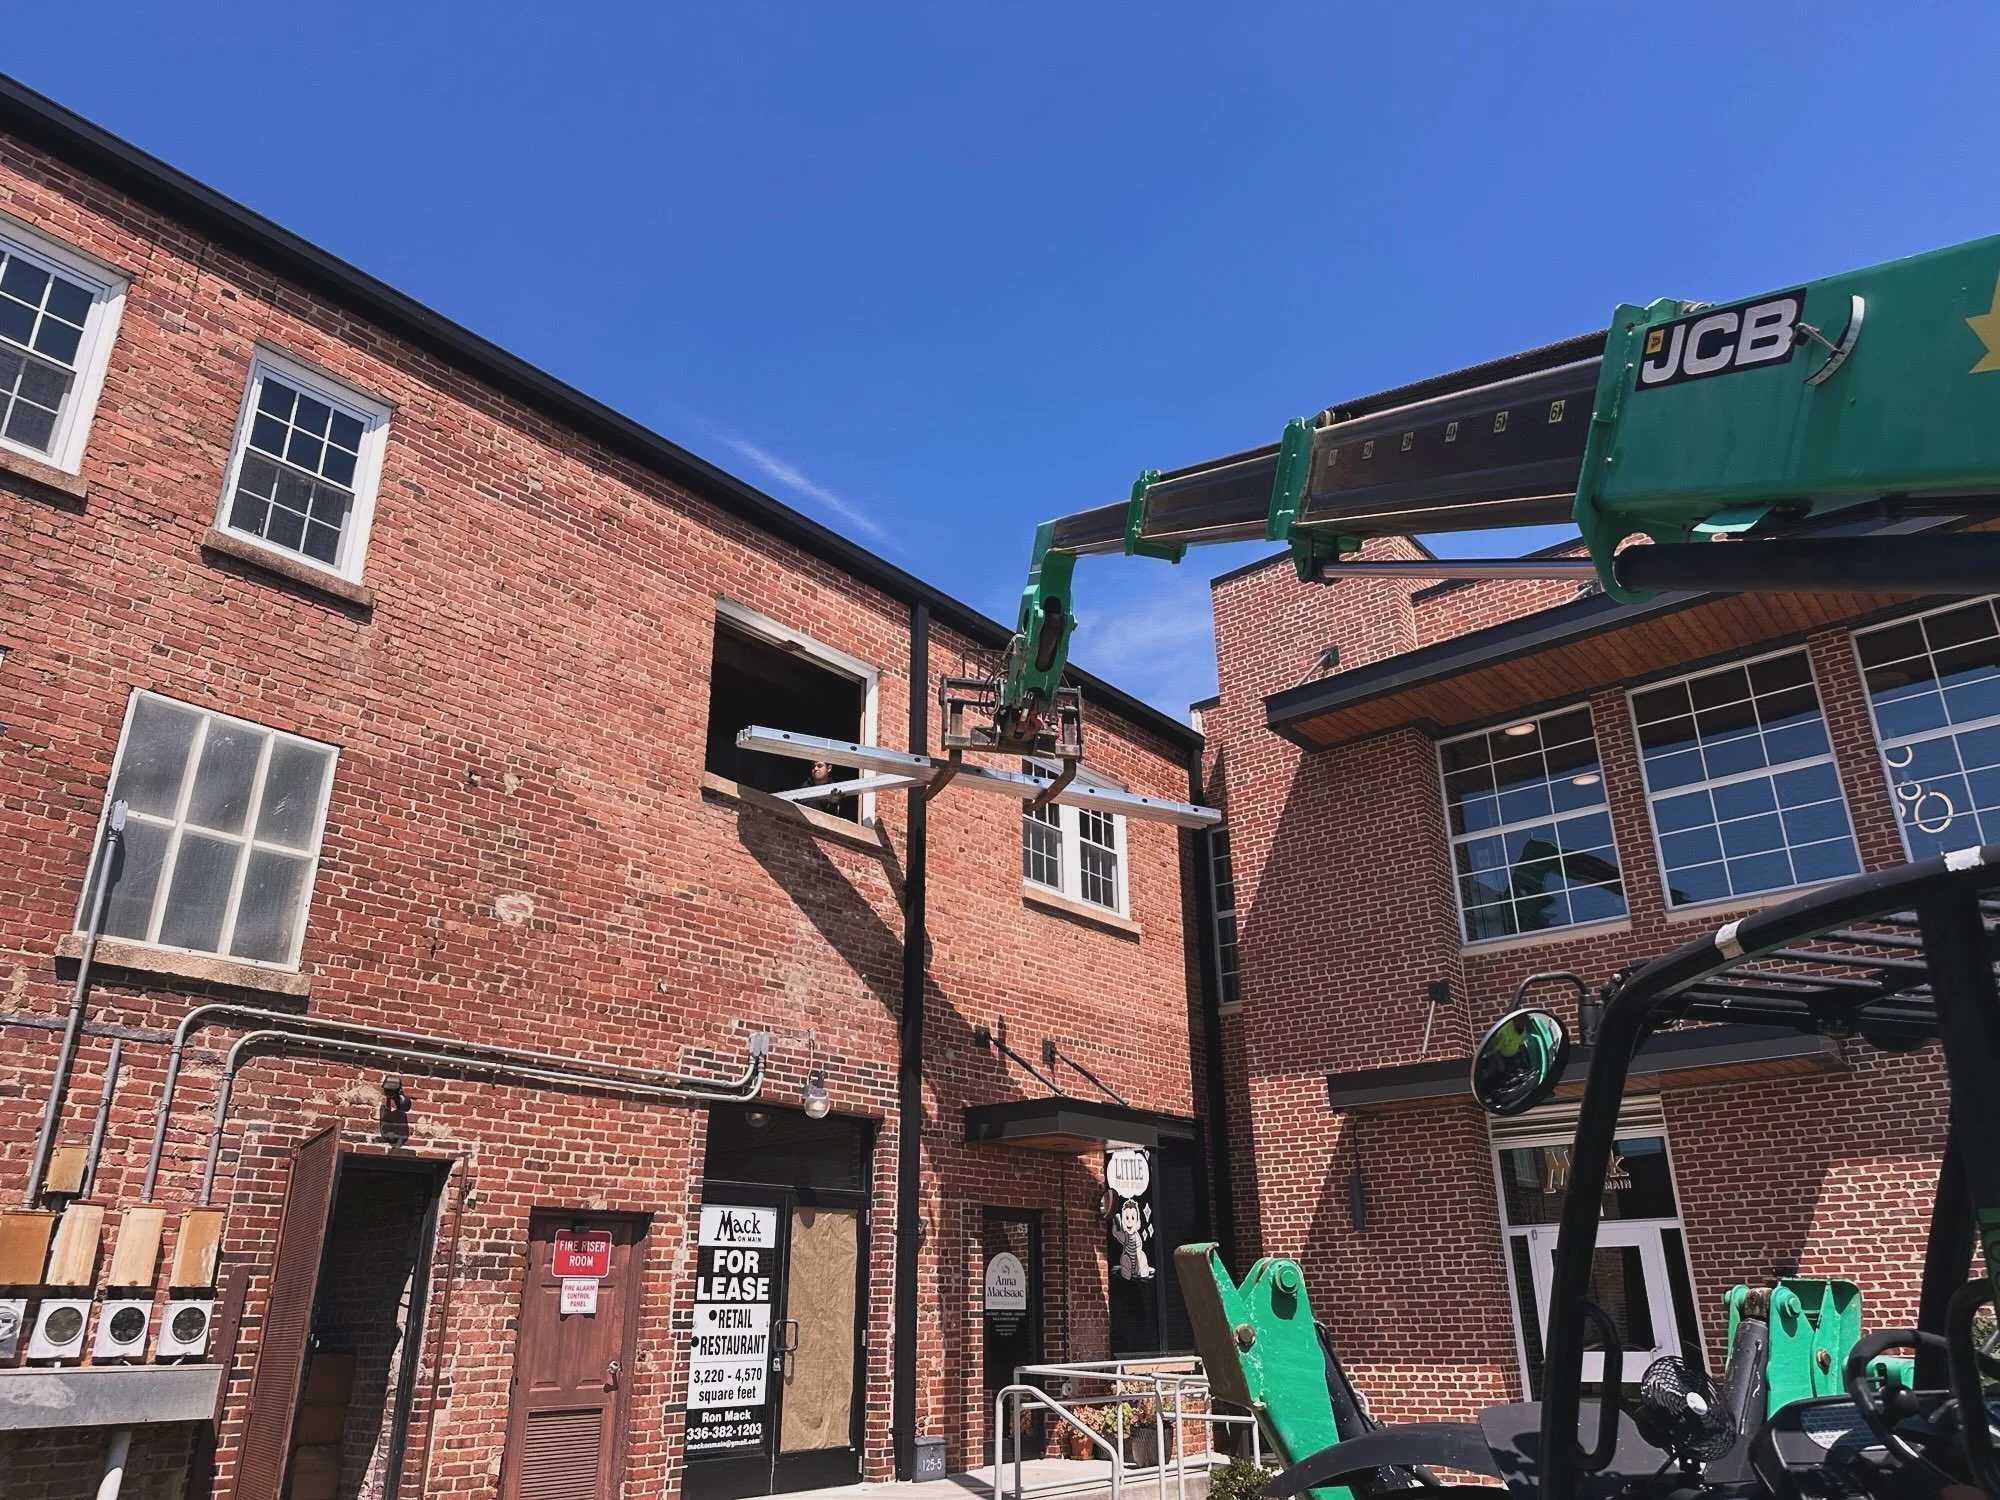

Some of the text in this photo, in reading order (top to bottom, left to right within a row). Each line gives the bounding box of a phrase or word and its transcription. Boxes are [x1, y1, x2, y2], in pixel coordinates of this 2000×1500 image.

[1641, 298, 1798, 384] JCB
[1114, 1158, 1144, 1181] LITTLE
[1544, 1148, 1630, 1194] Mk
[1605, 1179, 1632, 1190] MAIN
[714, 1210, 761, 1241] Mack
[559, 1240, 606, 1252] FIRE RISER
[569, 1256, 593, 1267] ROOM
[713, 1250, 759, 1274] FOR
[696, 1277, 770, 1301] LEASE
[995, 1275, 1016, 1286] Anna
[987, 1286, 1024, 1298] MacIsaac
[718, 1309, 752, 1328] RETAIL
[700, 1335, 766, 1355] RESTAURANT
[693, 1369, 724, 1385] 3,220
[735, 1367, 762, 1384] 4,570
[698, 1386, 756, 1404] square feet
[702, 1409, 751, 1423] Ron Mack
[686, 1423, 762, 1440] 336-382-1203
[922, 1458, 942, 1471] 125-5
